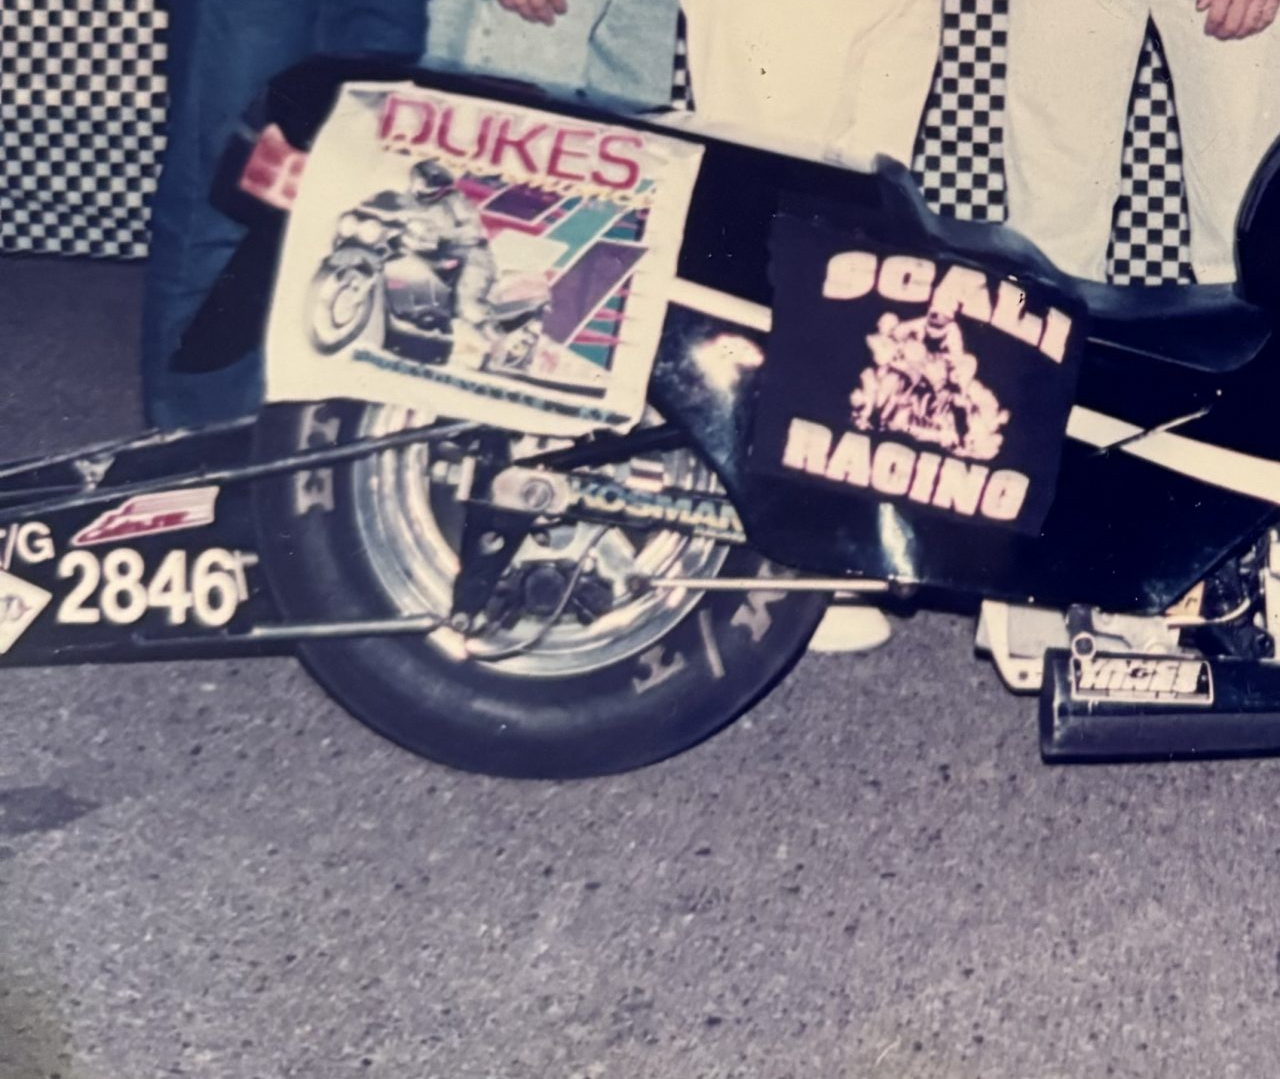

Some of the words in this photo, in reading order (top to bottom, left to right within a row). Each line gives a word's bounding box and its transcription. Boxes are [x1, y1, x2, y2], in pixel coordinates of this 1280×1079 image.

[377, 94, 645, 192] DUKES
[822, 251, 1072, 364] SCALI
[782, 417, 1030, 521] RACING
[0, 521, 55, 571] /G
